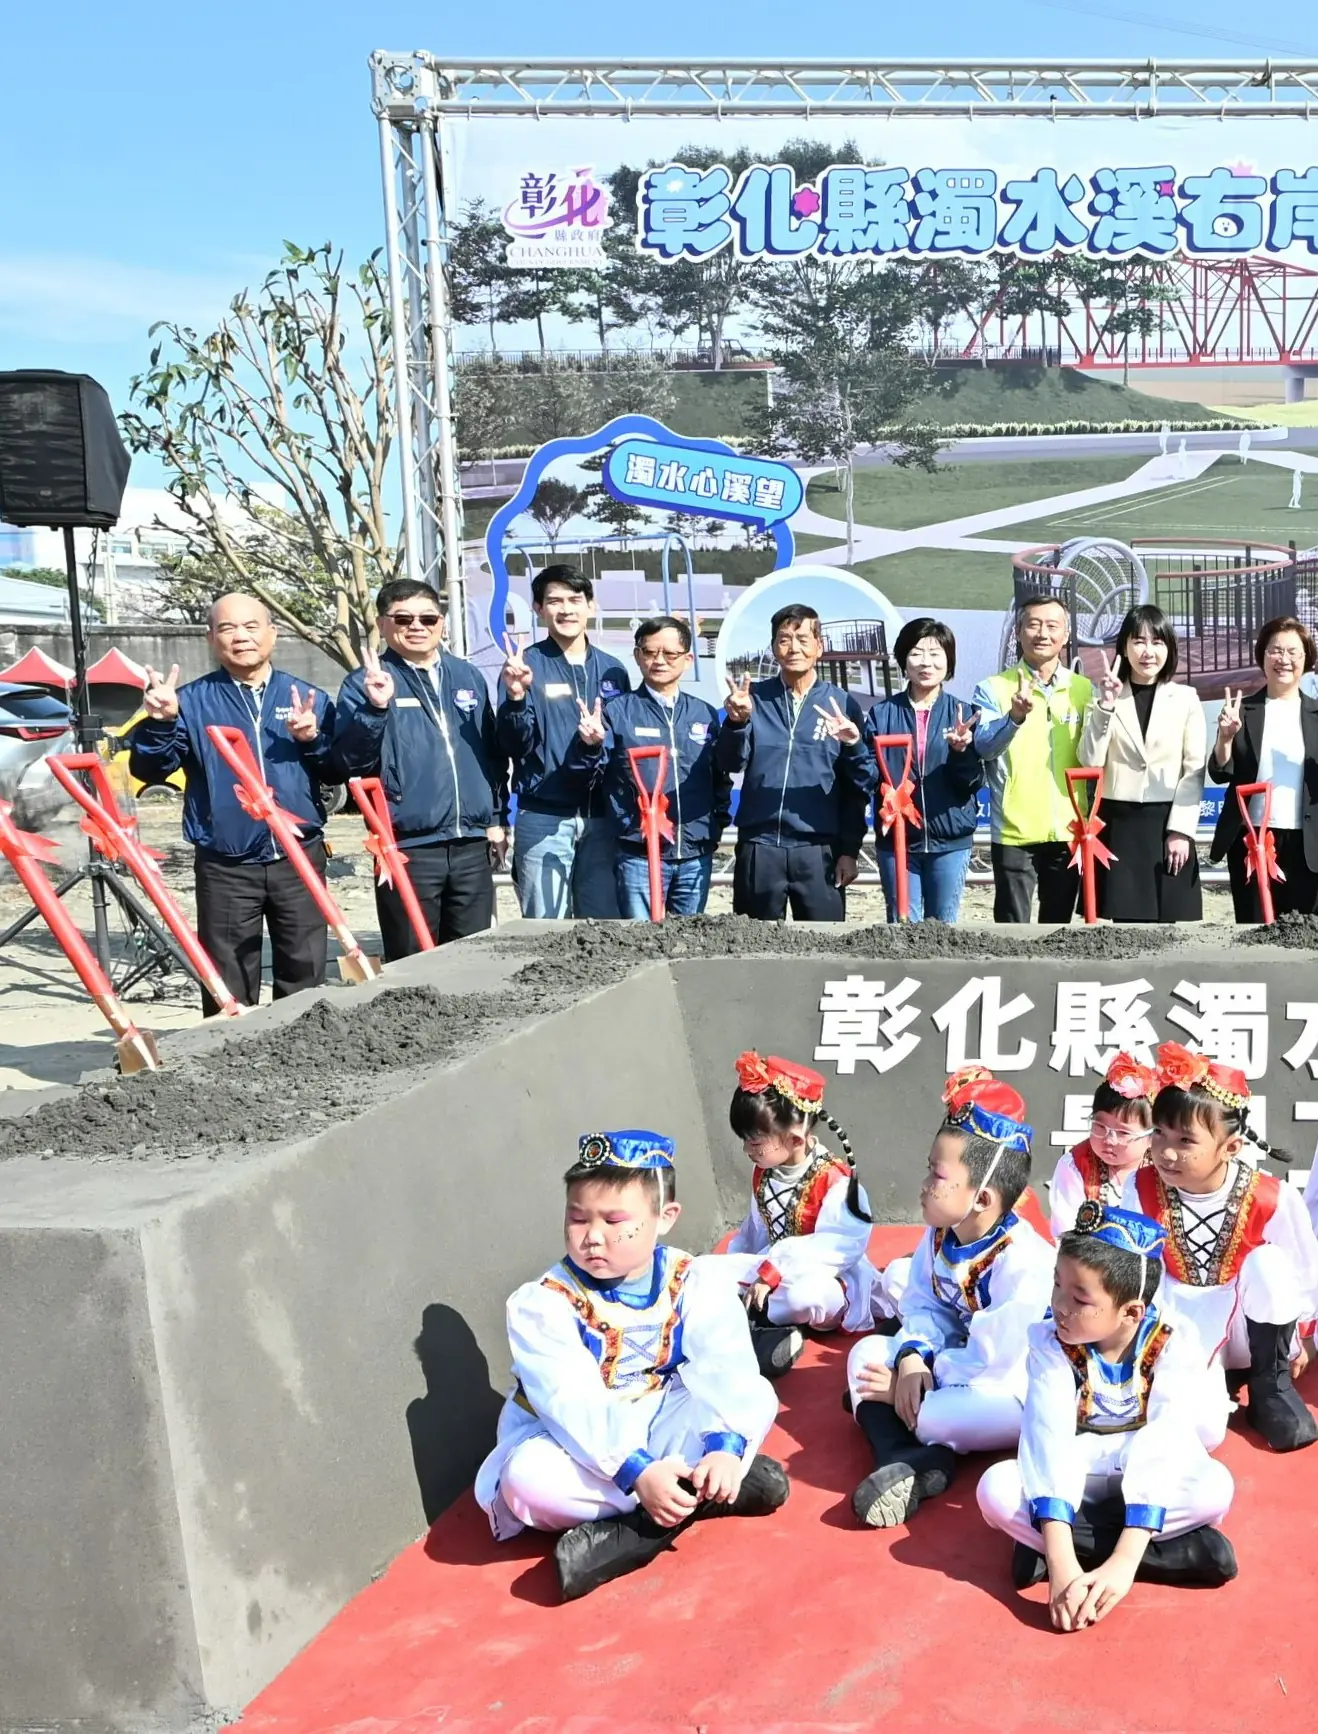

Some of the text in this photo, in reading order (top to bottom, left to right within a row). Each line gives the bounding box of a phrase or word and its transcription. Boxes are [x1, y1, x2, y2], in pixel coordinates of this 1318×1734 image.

[520, 171, 601, 227] 彰化
[510, 247, 602, 257] CHANGHUA
[624, 453, 786, 511] 濁水心溪望
